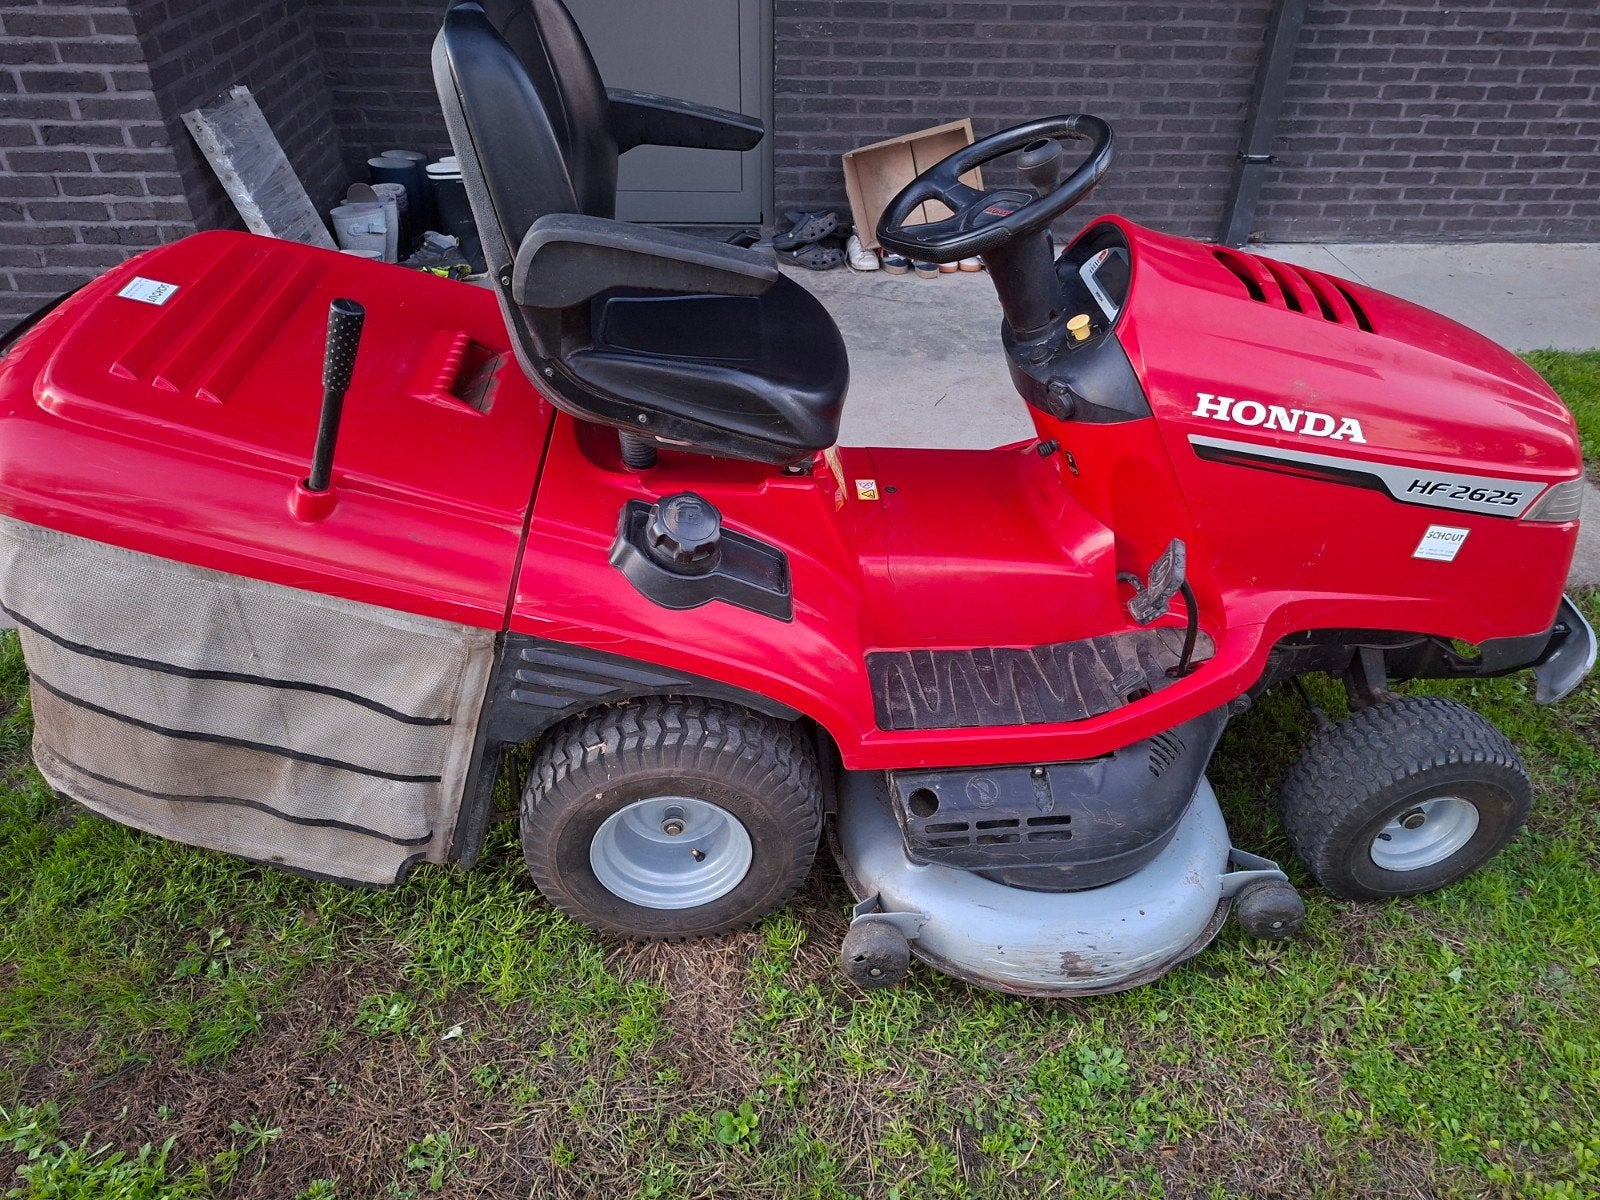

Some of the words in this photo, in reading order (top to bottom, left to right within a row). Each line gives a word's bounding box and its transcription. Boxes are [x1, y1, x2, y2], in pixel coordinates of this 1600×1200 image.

[1192, 392, 1367, 443] HONDA
[1406, 479, 1452, 496] HF
[1448, 485, 1523, 506] 2625
[1426, 530, 1465, 542] SCHOUT
